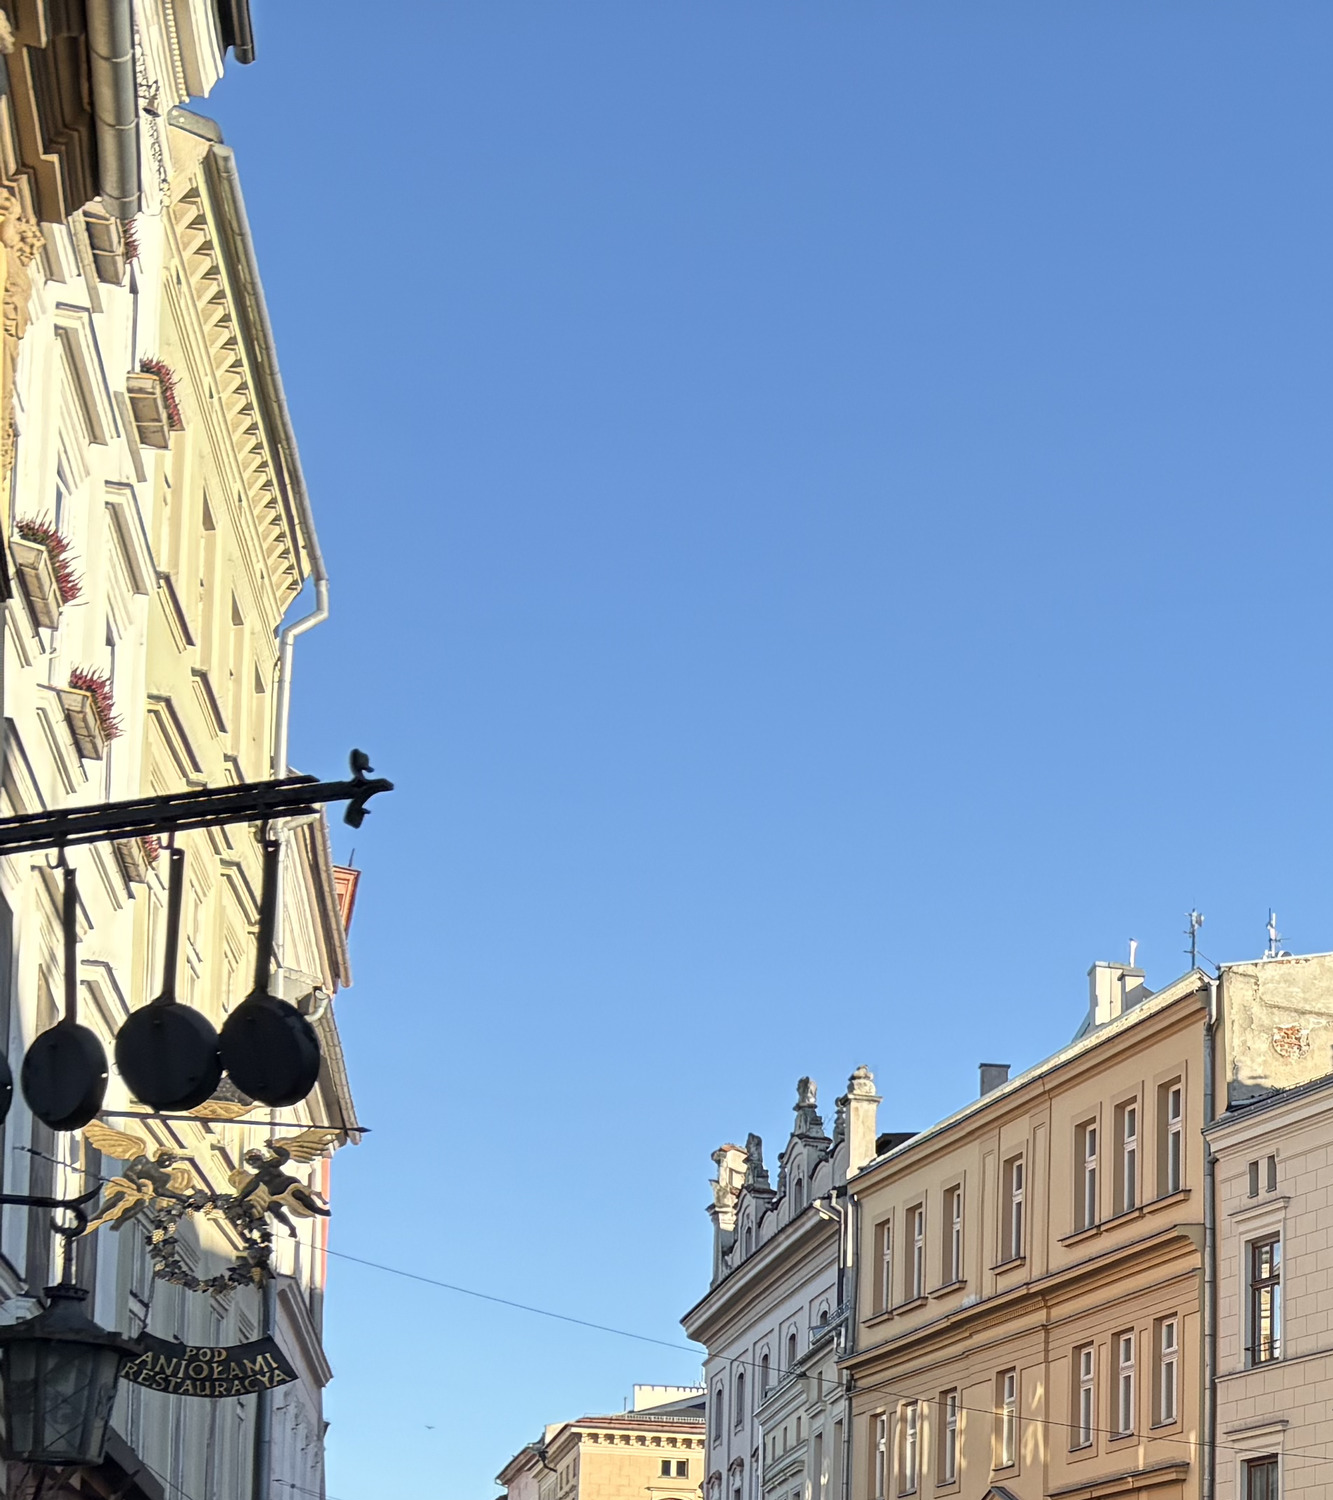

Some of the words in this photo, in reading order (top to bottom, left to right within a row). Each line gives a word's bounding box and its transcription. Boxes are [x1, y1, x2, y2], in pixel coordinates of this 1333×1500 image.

[134, 1351, 279, 1379] ANIOŁAMI
[185, 1347, 227, 1362] POD
[120, 1362, 291, 1396] RESTAURACYA
